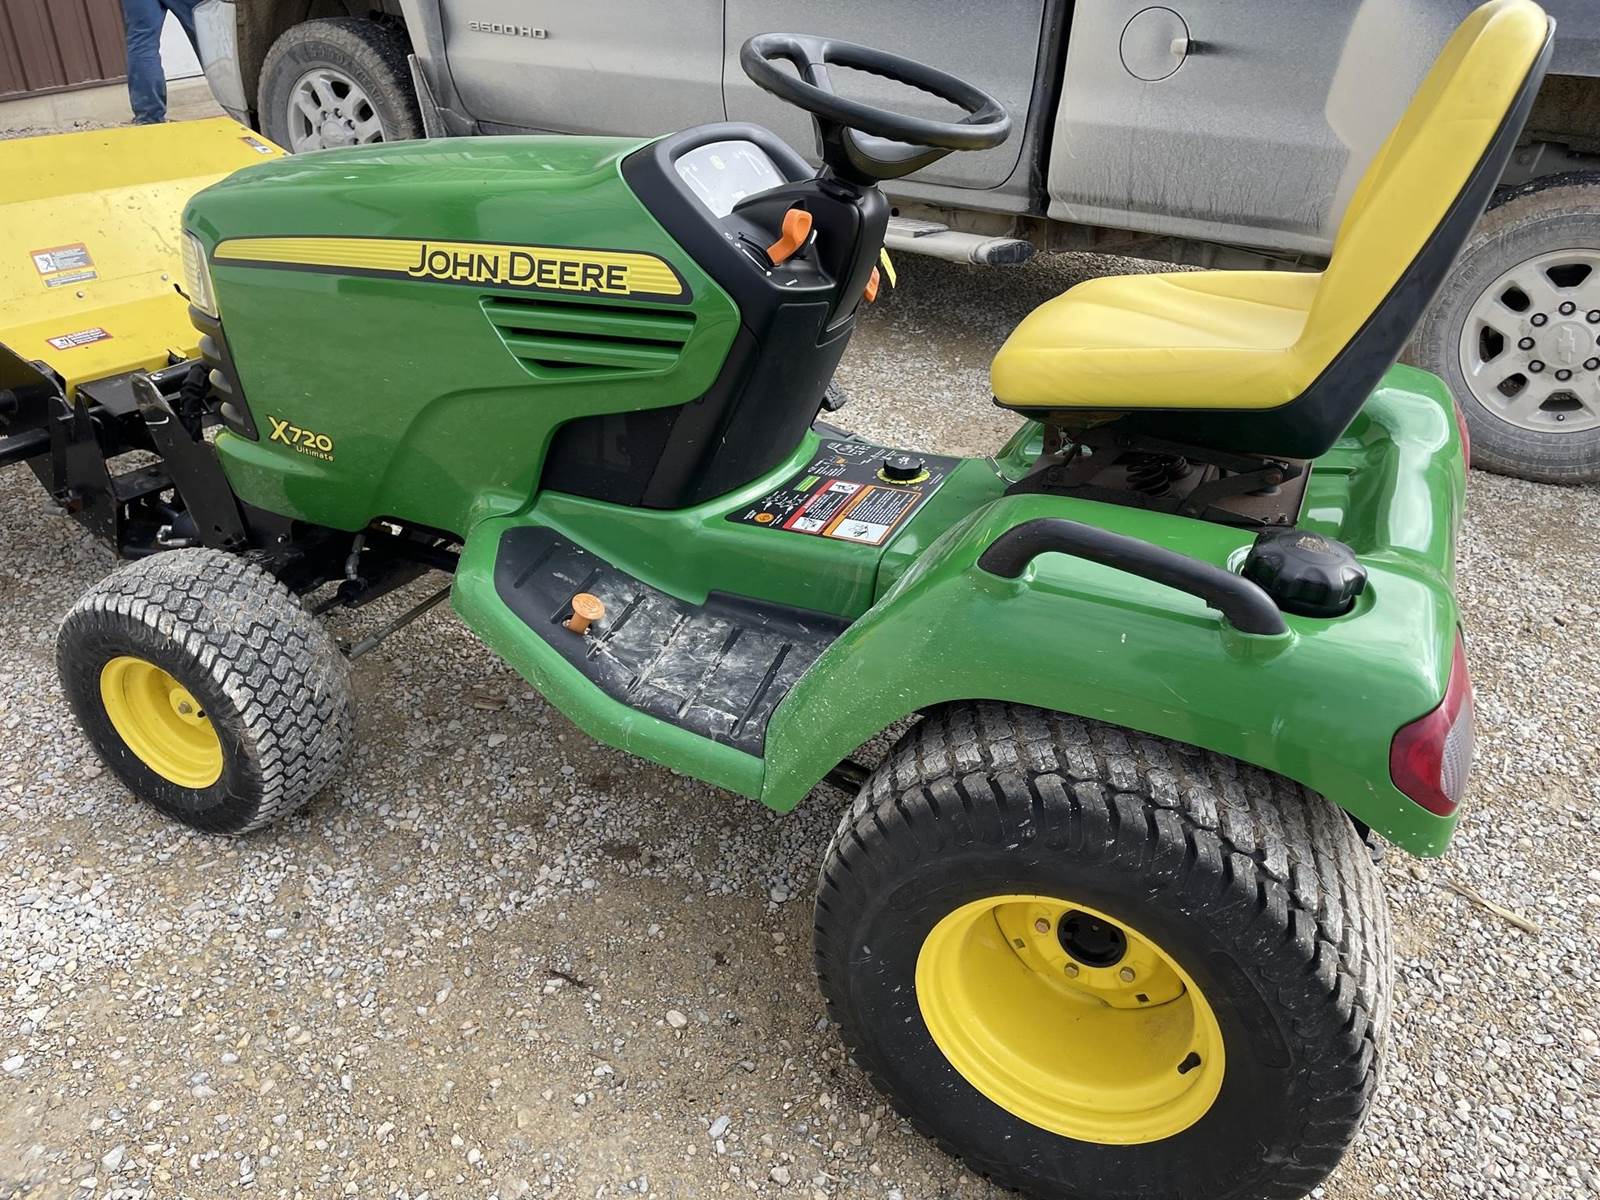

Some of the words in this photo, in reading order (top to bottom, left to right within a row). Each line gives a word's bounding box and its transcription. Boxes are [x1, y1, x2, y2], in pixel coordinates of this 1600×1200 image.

[468, 20, 517, 36] 3500
[519, 26, 549, 40] HD
[408, 243, 500, 281] JOHN
[508, 250, 629, 293] DEERE
[266, 415, 334, 453] X720
[296, 444, 335, 462] Ultimate
